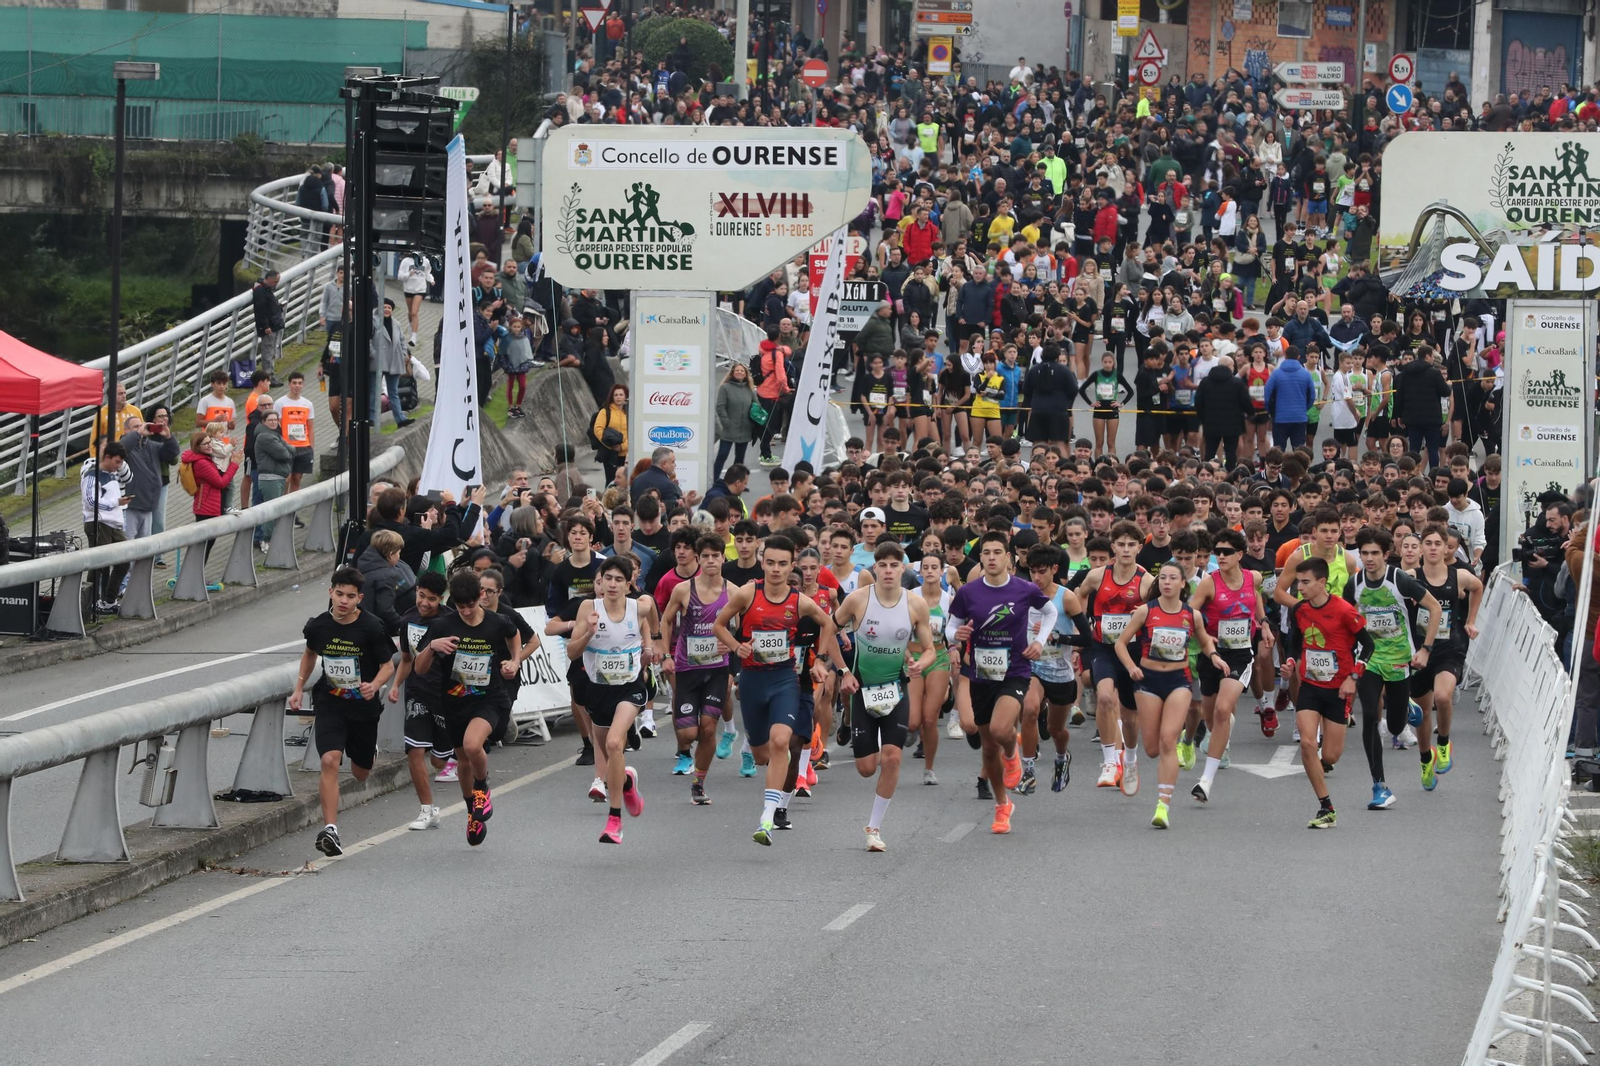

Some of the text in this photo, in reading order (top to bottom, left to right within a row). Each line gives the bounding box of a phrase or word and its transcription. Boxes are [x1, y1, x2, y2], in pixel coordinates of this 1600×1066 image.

[602, 146, 838, 166] Concello de OURENSE
[1508, 166, 1556, 180] SAN
[1508, 183, 1600, 197] MARTIN
[718, 193, 808, 218] XLVIII
[576, 208, 626, 224] SAN
[716, 222, 813, 236] OURENSE 9-11-2025
[576, 227, 676, 242] MARTIN
[575, 244, 692, 252] CARREIRA PEDESTRE POPULAR
[854, 240, 860, 254] 2
[575, 254, 692, 270] OURENSE
[1440, 230, 1600, 292] SAÍD
[873, 284, 878, 300] 1
[658, 315, 700, 325] CaixaBank
[1538, 346, 1578, 356] CaixaBank
[1527, 400, 1580, 408] OURENSE
[651, 430, 690, 439] aquaBona
[1534, 458, 1573, 467] CaixaBank
[1372, 619, 1392, 627] 3762
[1424, 616, 1444, 625] 38
[1225, 627, 1245, 635] 3868
[760, 638, 782, 648] 3830
[1161, 636, 1182, 646] 3492
[695, 643, 714, 652] 3867
[868, 645, 900, 654] COBELAS
[602, 661, 625, 669] 3875
[982, 656, 1003, 665] 3826
[1311, 658, 1330, 666] 3305
[329, 666, 351, 674] 3790
[462, 661, 485, 671] 3417
[872, 690, 895, 702] 3843
